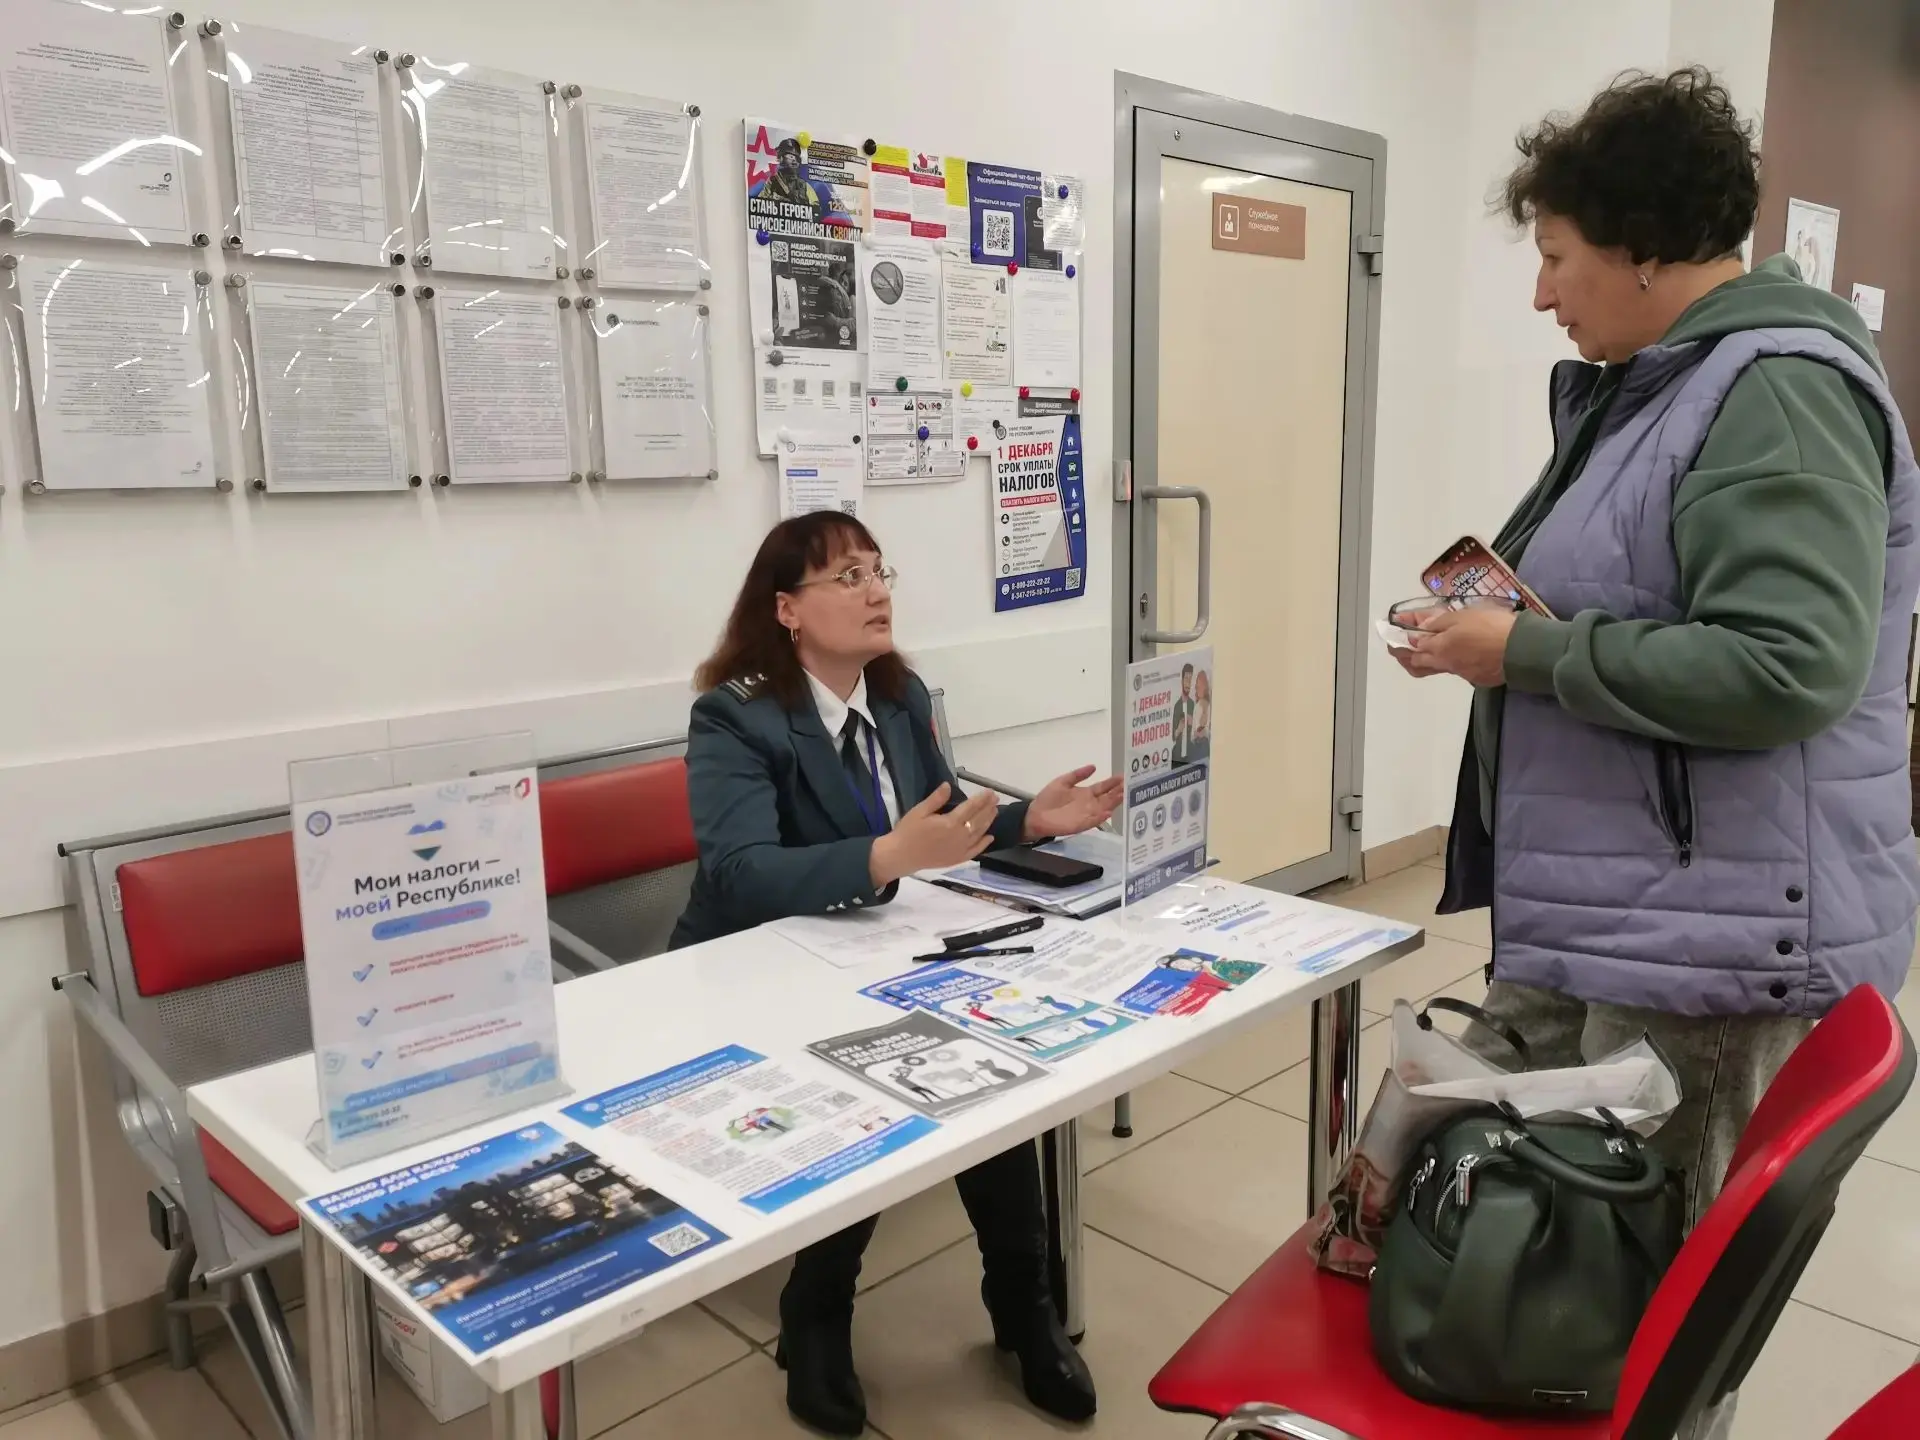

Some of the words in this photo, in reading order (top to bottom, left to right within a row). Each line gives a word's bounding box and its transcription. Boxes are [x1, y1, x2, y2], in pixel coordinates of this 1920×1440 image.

[977, 175, 1006, 185] Республики
[983, 168, 1017, 179] Официальный
[750, 199, 778, 216] СТАНЬ
[780, 202, 813, 220] ГЕРОЕМ
[1248, 207, 1279, 221] Служебное
[750, 215, 825, 237] ПРИСОЕДИНЯЙСЯ
[826, 224, 832, 239] К
[790, 250, 847, 262] ПСИХОЛОГИЧЕСКАЯ
[790, 258, 830, 268] ПОДДЕРЖКА
[997, 446, 1003, 459] 1
[1008, 442, 1054, 461] ДЕКАБРЯ
[998, 462, 1021, 474] СРОК
[1024, 459, 1054, 472] УПЛАТЫ
[999, 472, 1055, 493] НАЛОГОВ
[1002, 498, 1023, 507] ПЛАТИТЬ
[1023, 496, 1040, 504] НАЛОГИ
[1040, 493, 1056, 502] ПРОСТО
[1132, 701, 1137, 713] 1
[1139, 690, 1171, 713] ДЕКАБРЯ
[1132, 715, 1147, 728] СРОК
[1148, 708, 1171, 724] УПЛАТЫ
[1132, 722, 1171, 748] НАЛОГОВ
[1136, 785, 1160, 804] ПЛАТИТЬ
[1160, 777, 1181, 793] НАЛОГИ
[1182, 769, 1202, 786] ПРОСТО
[354, 874, 401, 895] Мои
[407, 859, 480, 885] налоги
[335, 893, 392, 922] моей
[397, 867, 521, 908] Республике!
